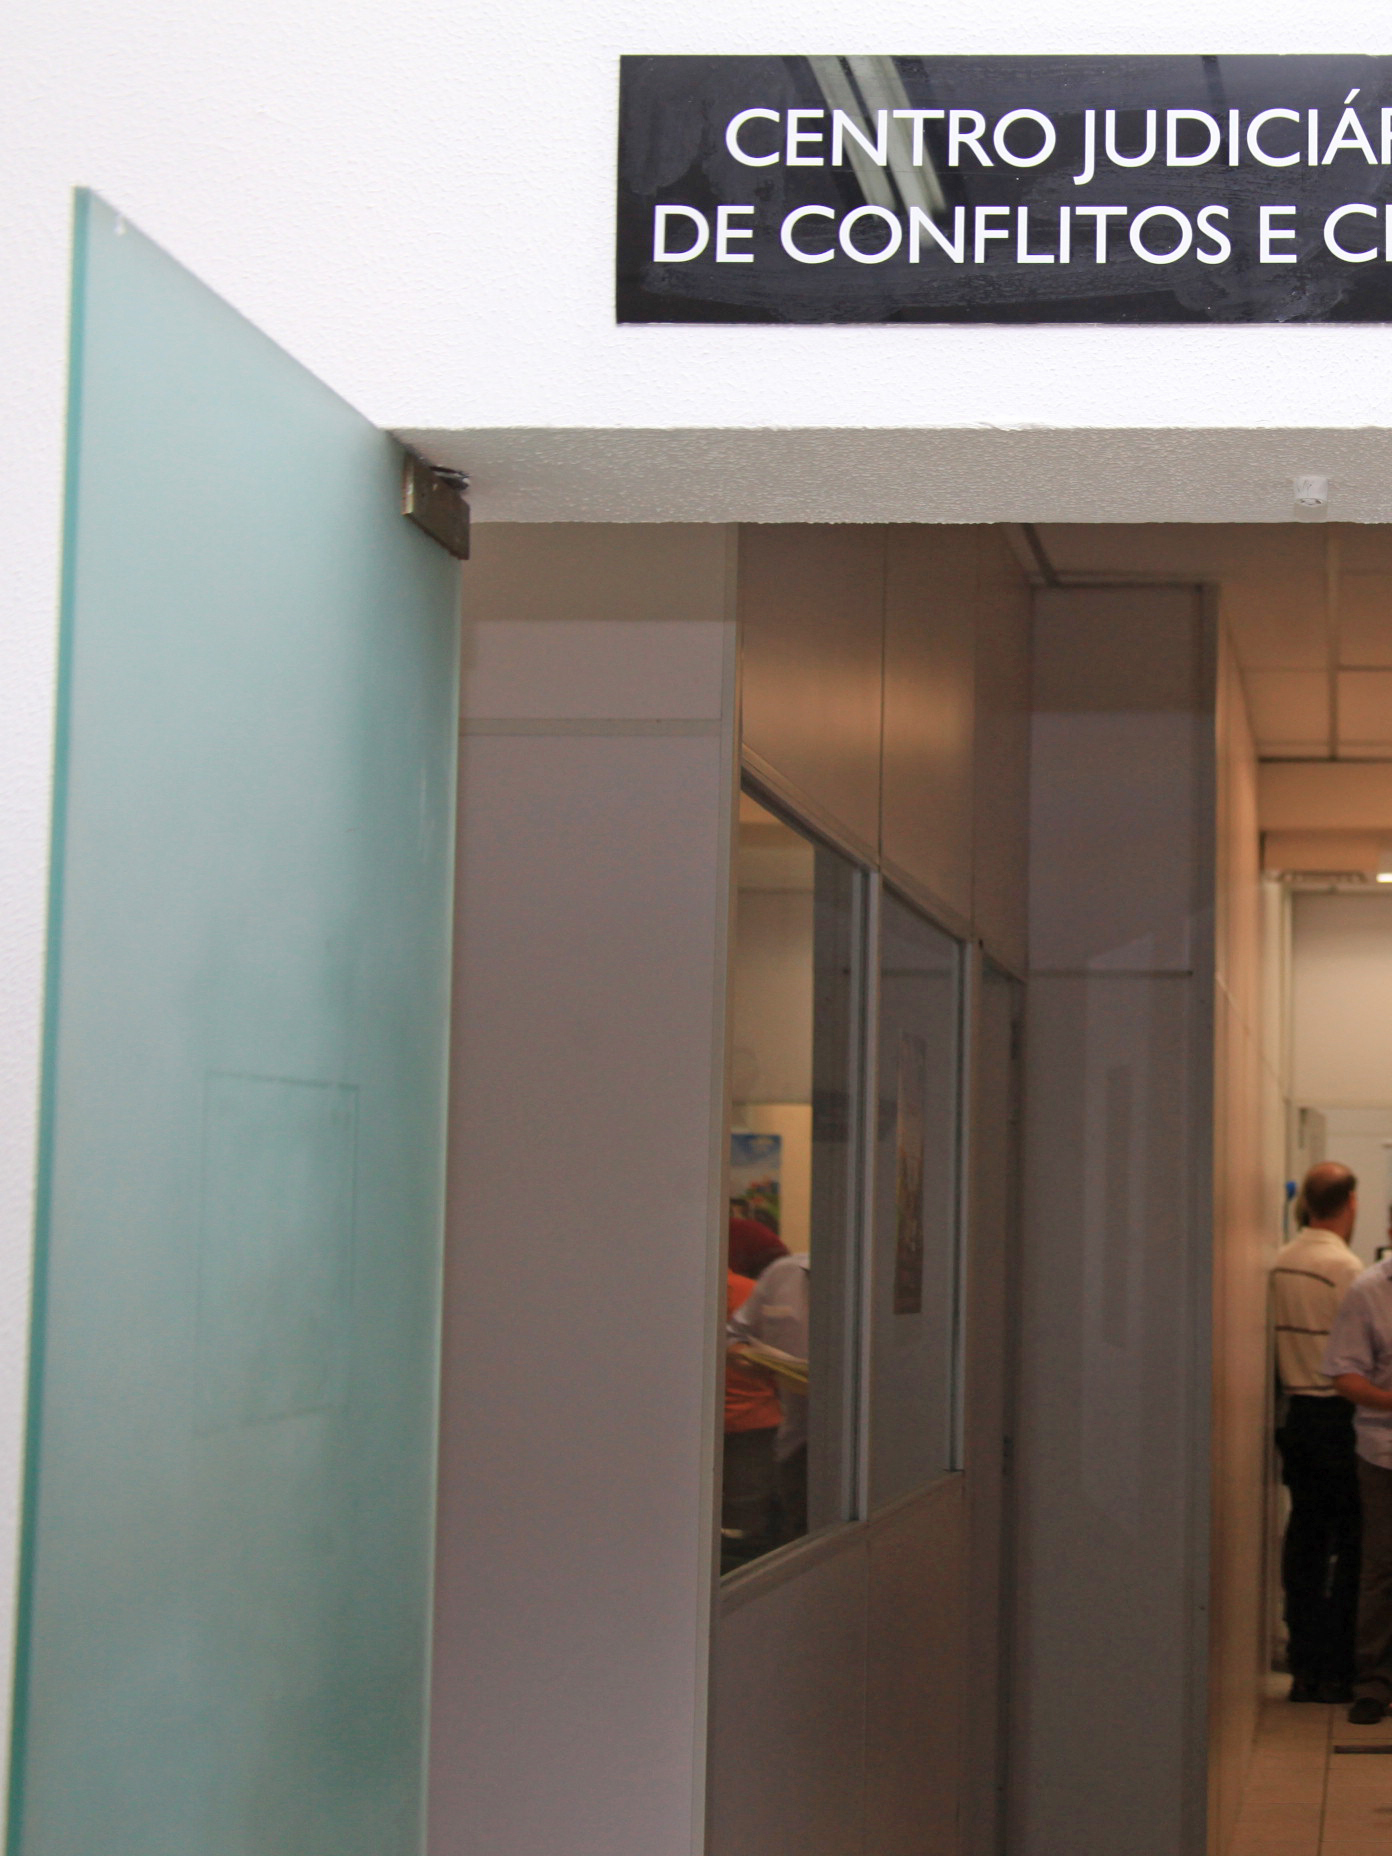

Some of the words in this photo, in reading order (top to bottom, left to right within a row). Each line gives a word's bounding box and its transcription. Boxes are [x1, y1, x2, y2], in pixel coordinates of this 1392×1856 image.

[725, 107, 1056, 168] CENTRO
[653, 205, 755, 264] DE
[780, 204, 1231, 265] CONFLITOS
[1259, 205, 1297, 264] E
